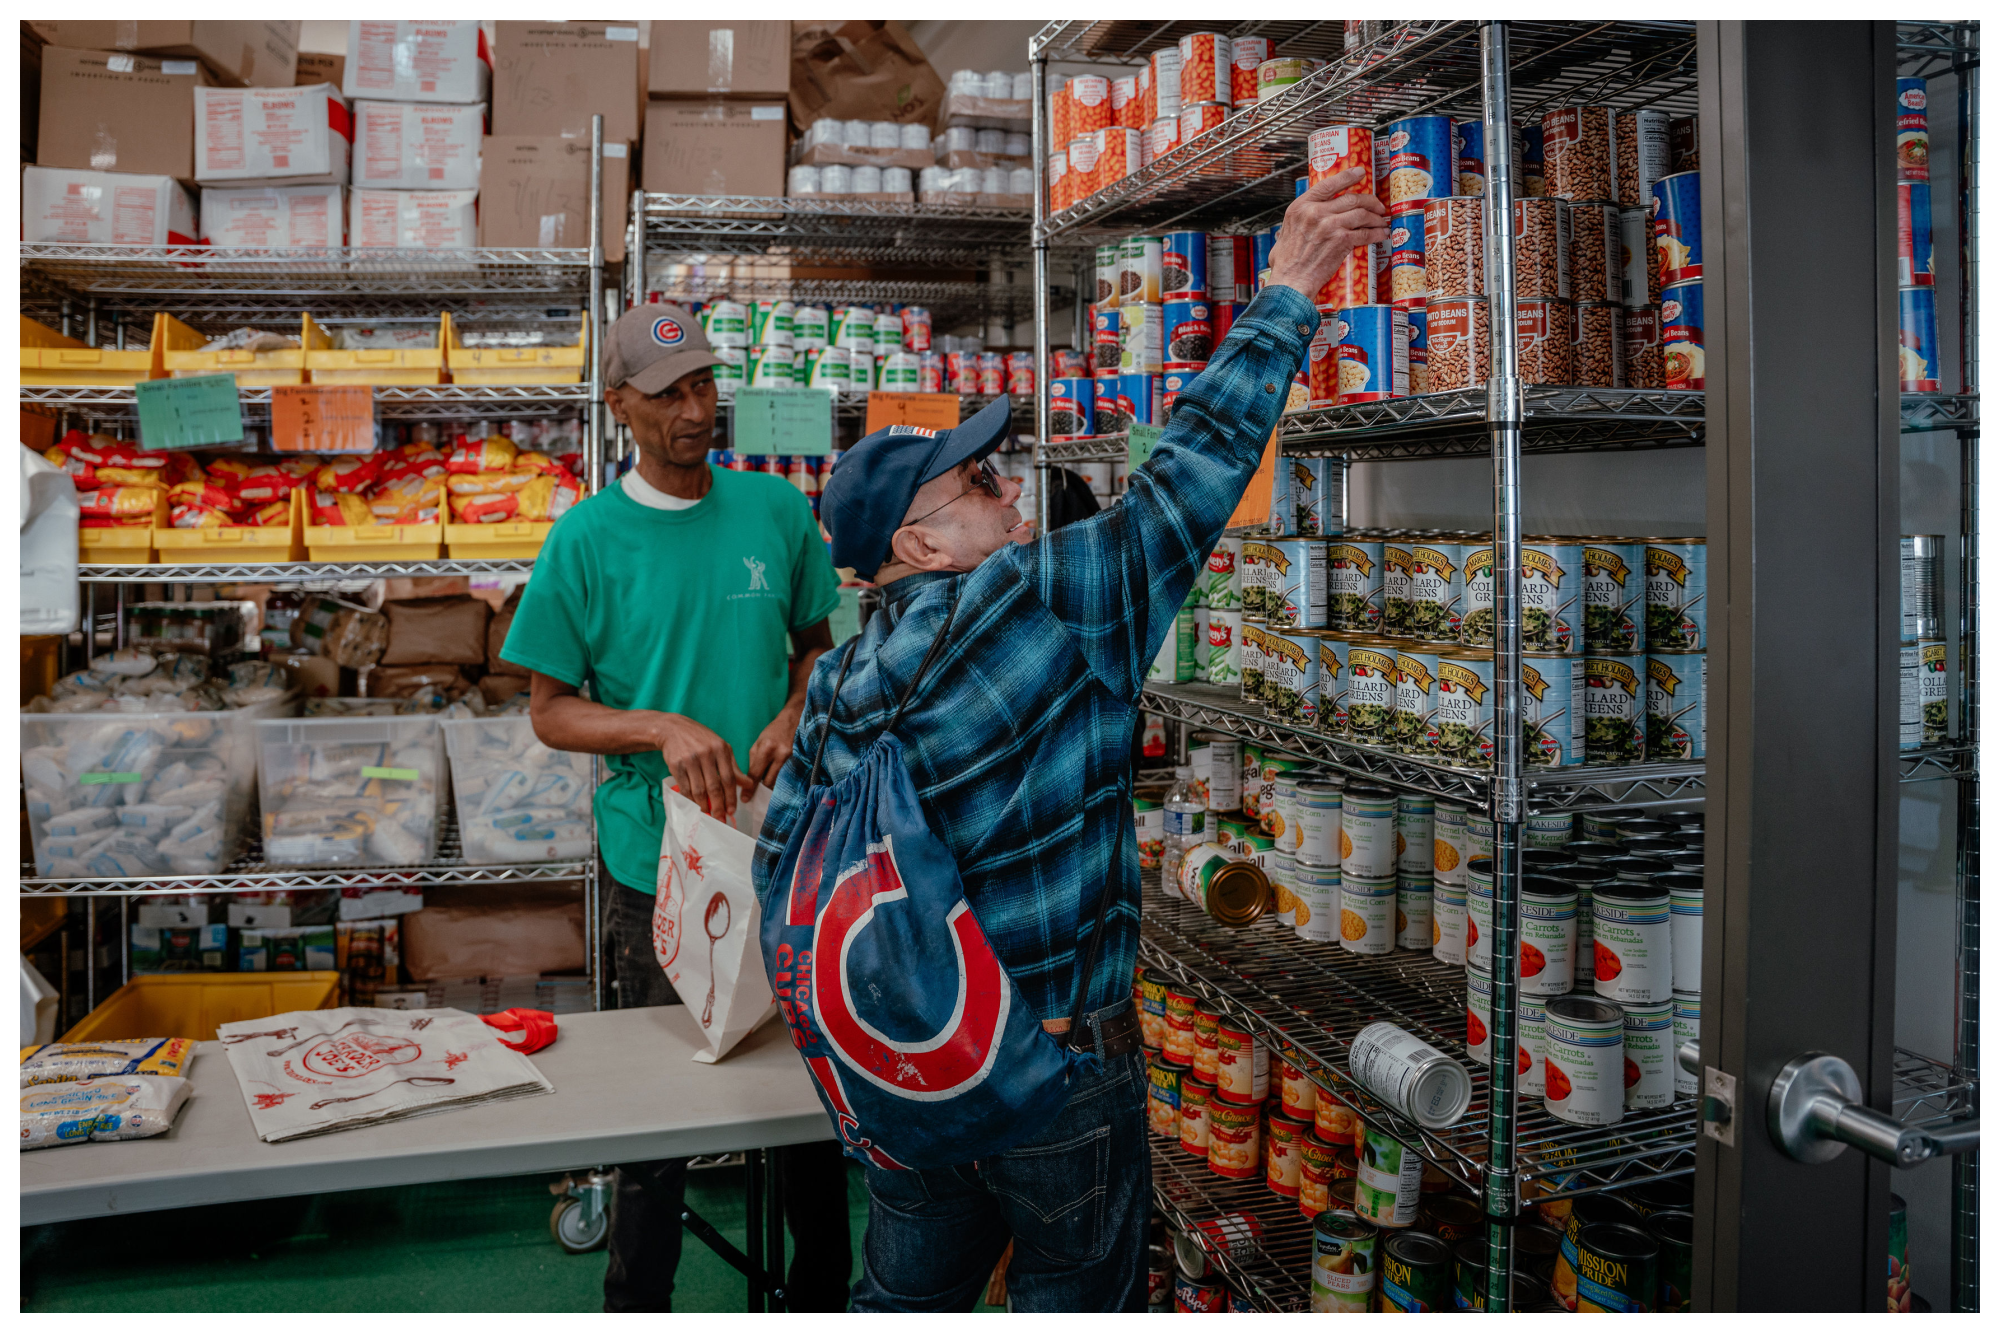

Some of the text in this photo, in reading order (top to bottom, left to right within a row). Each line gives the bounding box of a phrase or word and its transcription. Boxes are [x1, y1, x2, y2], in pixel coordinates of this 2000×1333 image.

[1551, 113, 1576, 127] BEANS
[1314, 139, 1331, 149] BEANS
[1427, 207, 1446, 220] BEANS
[1440, 308, 1467, 319] BEANS
[1518, 309, 1544, 319] BEANS
[1626, 317, 1653, 326] BEANS
[1178, 326, 1197, 334] Black
[1132, 427, 1146, 437] Small
[1419, 552, 1446, 567] HOLMES
[1469, 553, 1493, 567] MARGAR
[1522, 553, 1552, 569] HOLMES
[1588, 552, 1618, 567] HOLMES
[1649, 552, 1679, 568] HOLMES
[1385, 576, 1408, 586] LARD
[1365, 653, 1392, 670] HOLMES
[1448, 668, 1475, 686] HOLMES
[1602, 662, 1631, 680] HOLMES
[1349, 682, 1388, 692] OLLARD
[1920, 687, 1947, 697] GREE
[1585, 692, 1628, 704] LLARD
[1438, 699, 1472, 710] LLARD
[1585, 703, 1623, 714] REENS
[1530, 819, 1568, 828] LAKESIDE
[1541, 833, 1563, 842] Kernel
[1348, 895, 1387, 906] Kernel Corn
[1521, 904, 1555, 917] KESIDE
[1526, 921, 1559, 933] Carrots
[1602, 923, 1634, 936] Carrots
[1535, 931, 1566, 940] Rebanadas
[1610, 934, 1643, 944] Rebanadas
[775, 943, 807, 1049] CUBS
[794, 950, 817, 1044] CHICAGO
[1519, 1007, 1540, 1017] SIDE
[1624, 1016, 1647, 1027] SIDE
[1519, 1024, 1545, 1033] arrots
[1546, 1025, 1579, 1041] AKESIDE
[1625, 1034, 1653, 1043] arrots
[1553, 1043, 1585, 1058] Carrots
[1628, 1041, 1660, 1051] Rebanadas
[315, 1049, 359, 1072] JOE'S
[330, 1041, 381, 1070] TRADER
[1560, 1054, 1594, 1066] Rebanadas
[1151, 1068, 1177, 1086] SSION
[1221, 1109, 1252, 1122] Choice
[1384, 1253, 1412, 1287] SSION
[1578, 1244, 1628, 1287] MISSION
[1326, 1273, 1351, 1284] SLICED
[1582, 1265, 1616, 1288] PRIDE
[1327, 1279, 1350, 1290] PEARS
